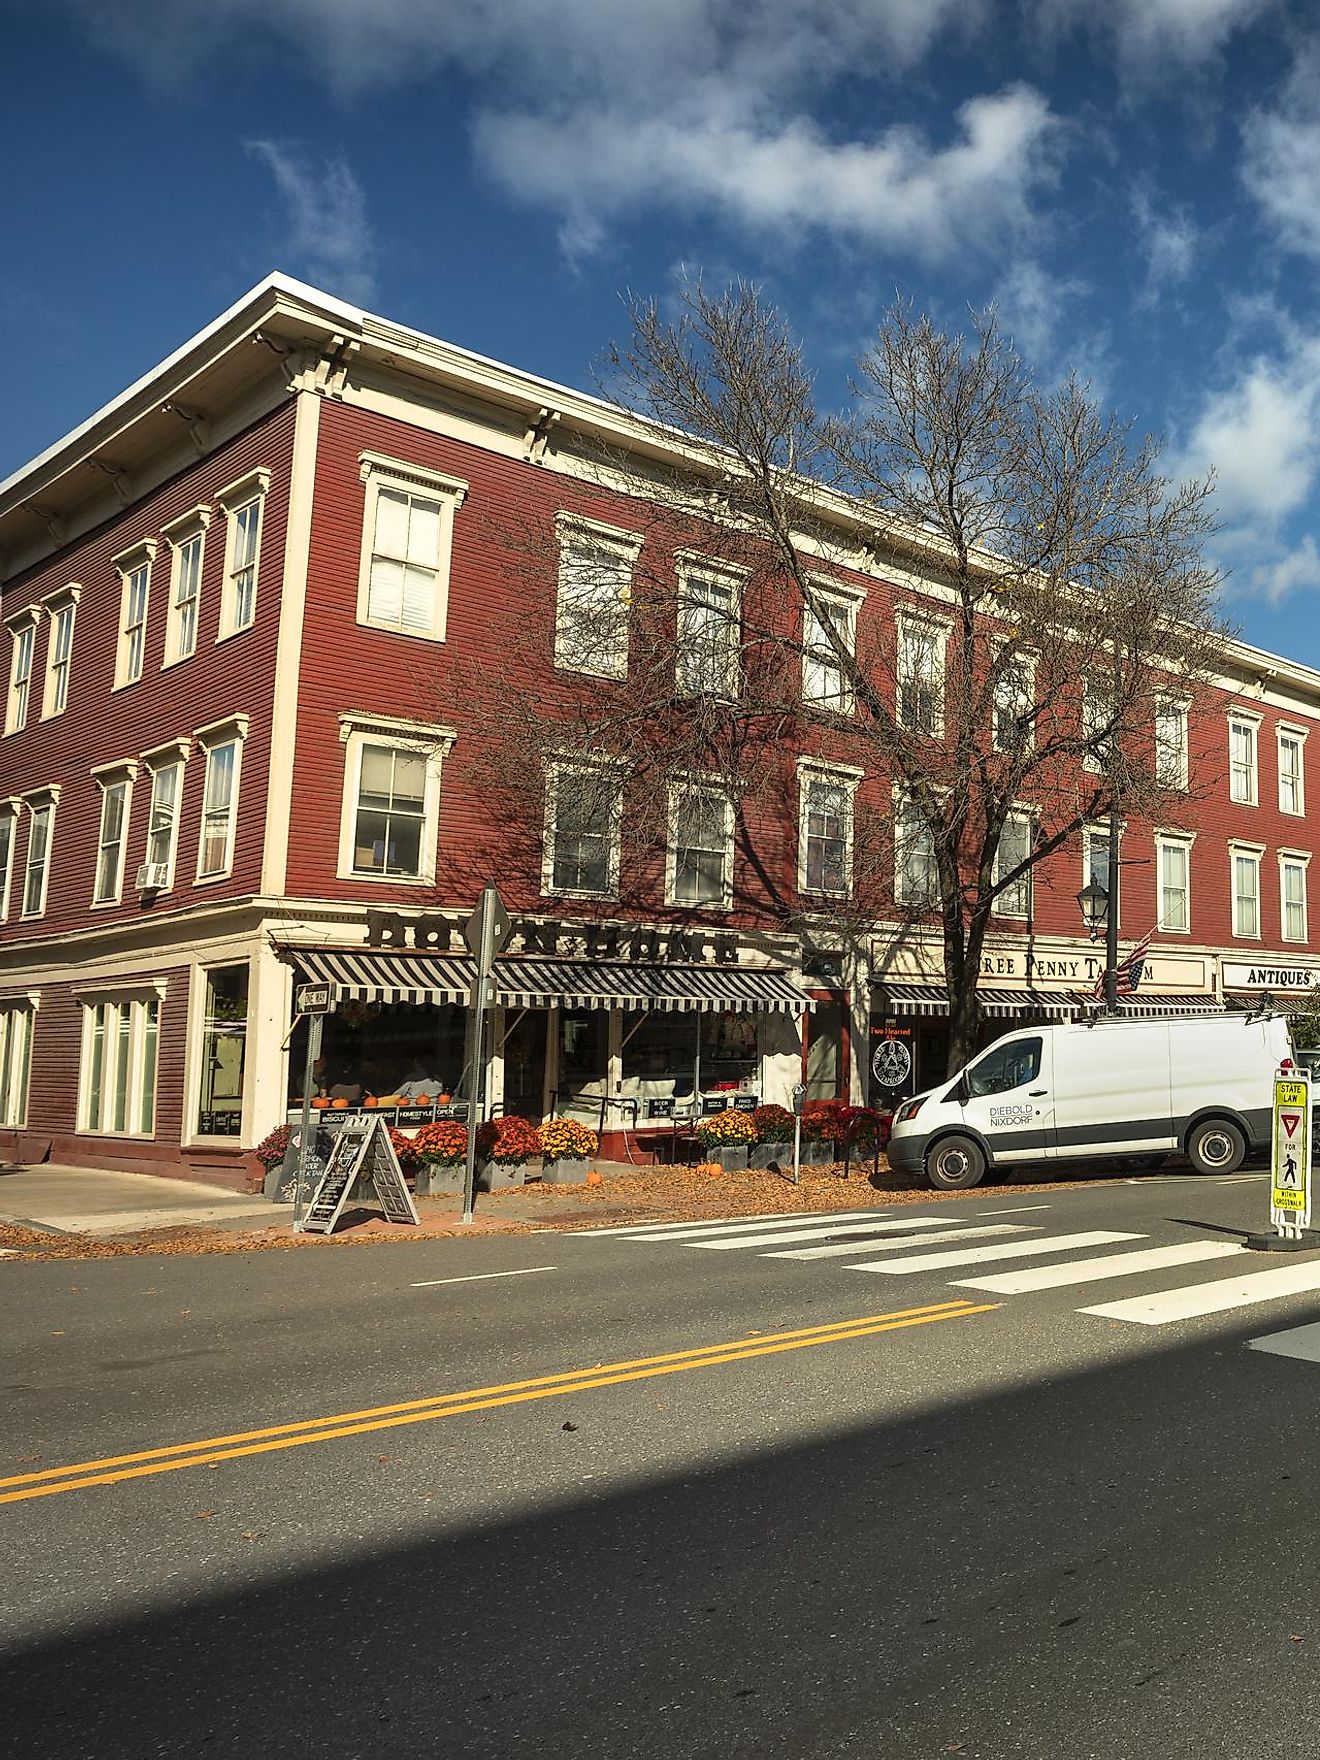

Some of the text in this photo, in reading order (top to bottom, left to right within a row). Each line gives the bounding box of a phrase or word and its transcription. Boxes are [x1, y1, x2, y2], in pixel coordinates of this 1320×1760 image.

[1024, 954, 1079, 977] PENNY
[1247, 968, 1311, 987] ANTIQUES
[1281, 1084, 1301, 1093] STATE
[990, 1105, 1033, 1116] DIEBOLD
[990, 1116, 1033, 1127] NIXDORF
[1285, 1143, 1296, 1151] FOR
